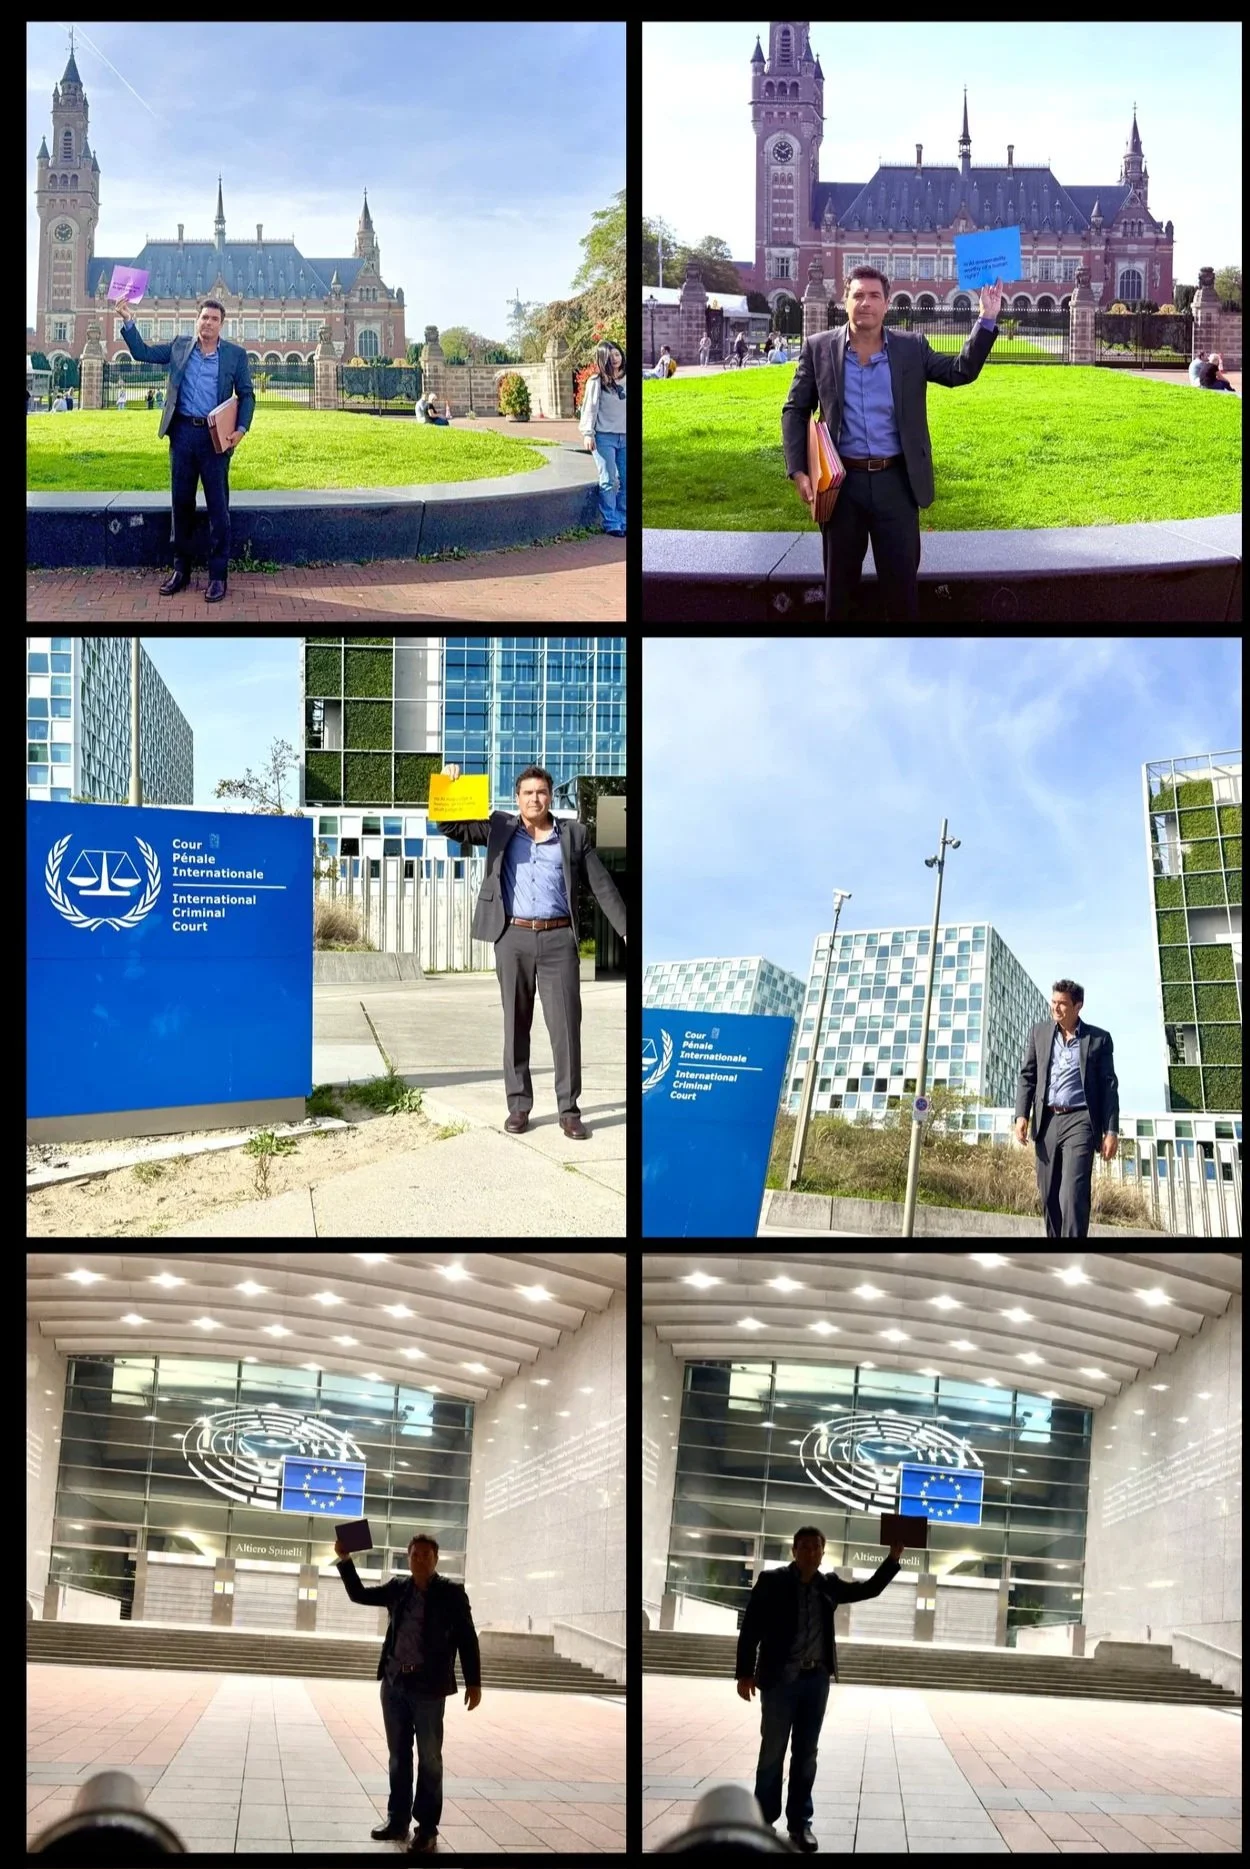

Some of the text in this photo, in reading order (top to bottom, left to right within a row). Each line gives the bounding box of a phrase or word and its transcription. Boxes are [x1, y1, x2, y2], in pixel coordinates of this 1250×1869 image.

[172, 838, 202, 850] Cour
[172, 852, 215, 864] Pénale
[172, 866, 264, 880] Internationale
[172, 893, 256, 905] International
[172, 907, 225, 918] Criminal
[172, 921, 208, 932] Court
[685, 1031, 706, 1039] Cour
[682, 1041, 713, 1050] Pénale
[680, 1050, 747, 1063] Internationale
[675, 1070, 738, 1082] International
[672, 1080, 712, 1090] Criminal
[670, 1091, 696, 1100] Court
[235, 1543, 303, 1557] Altiero Spinelli
[852, 1551, 884, 1562] Altiero
